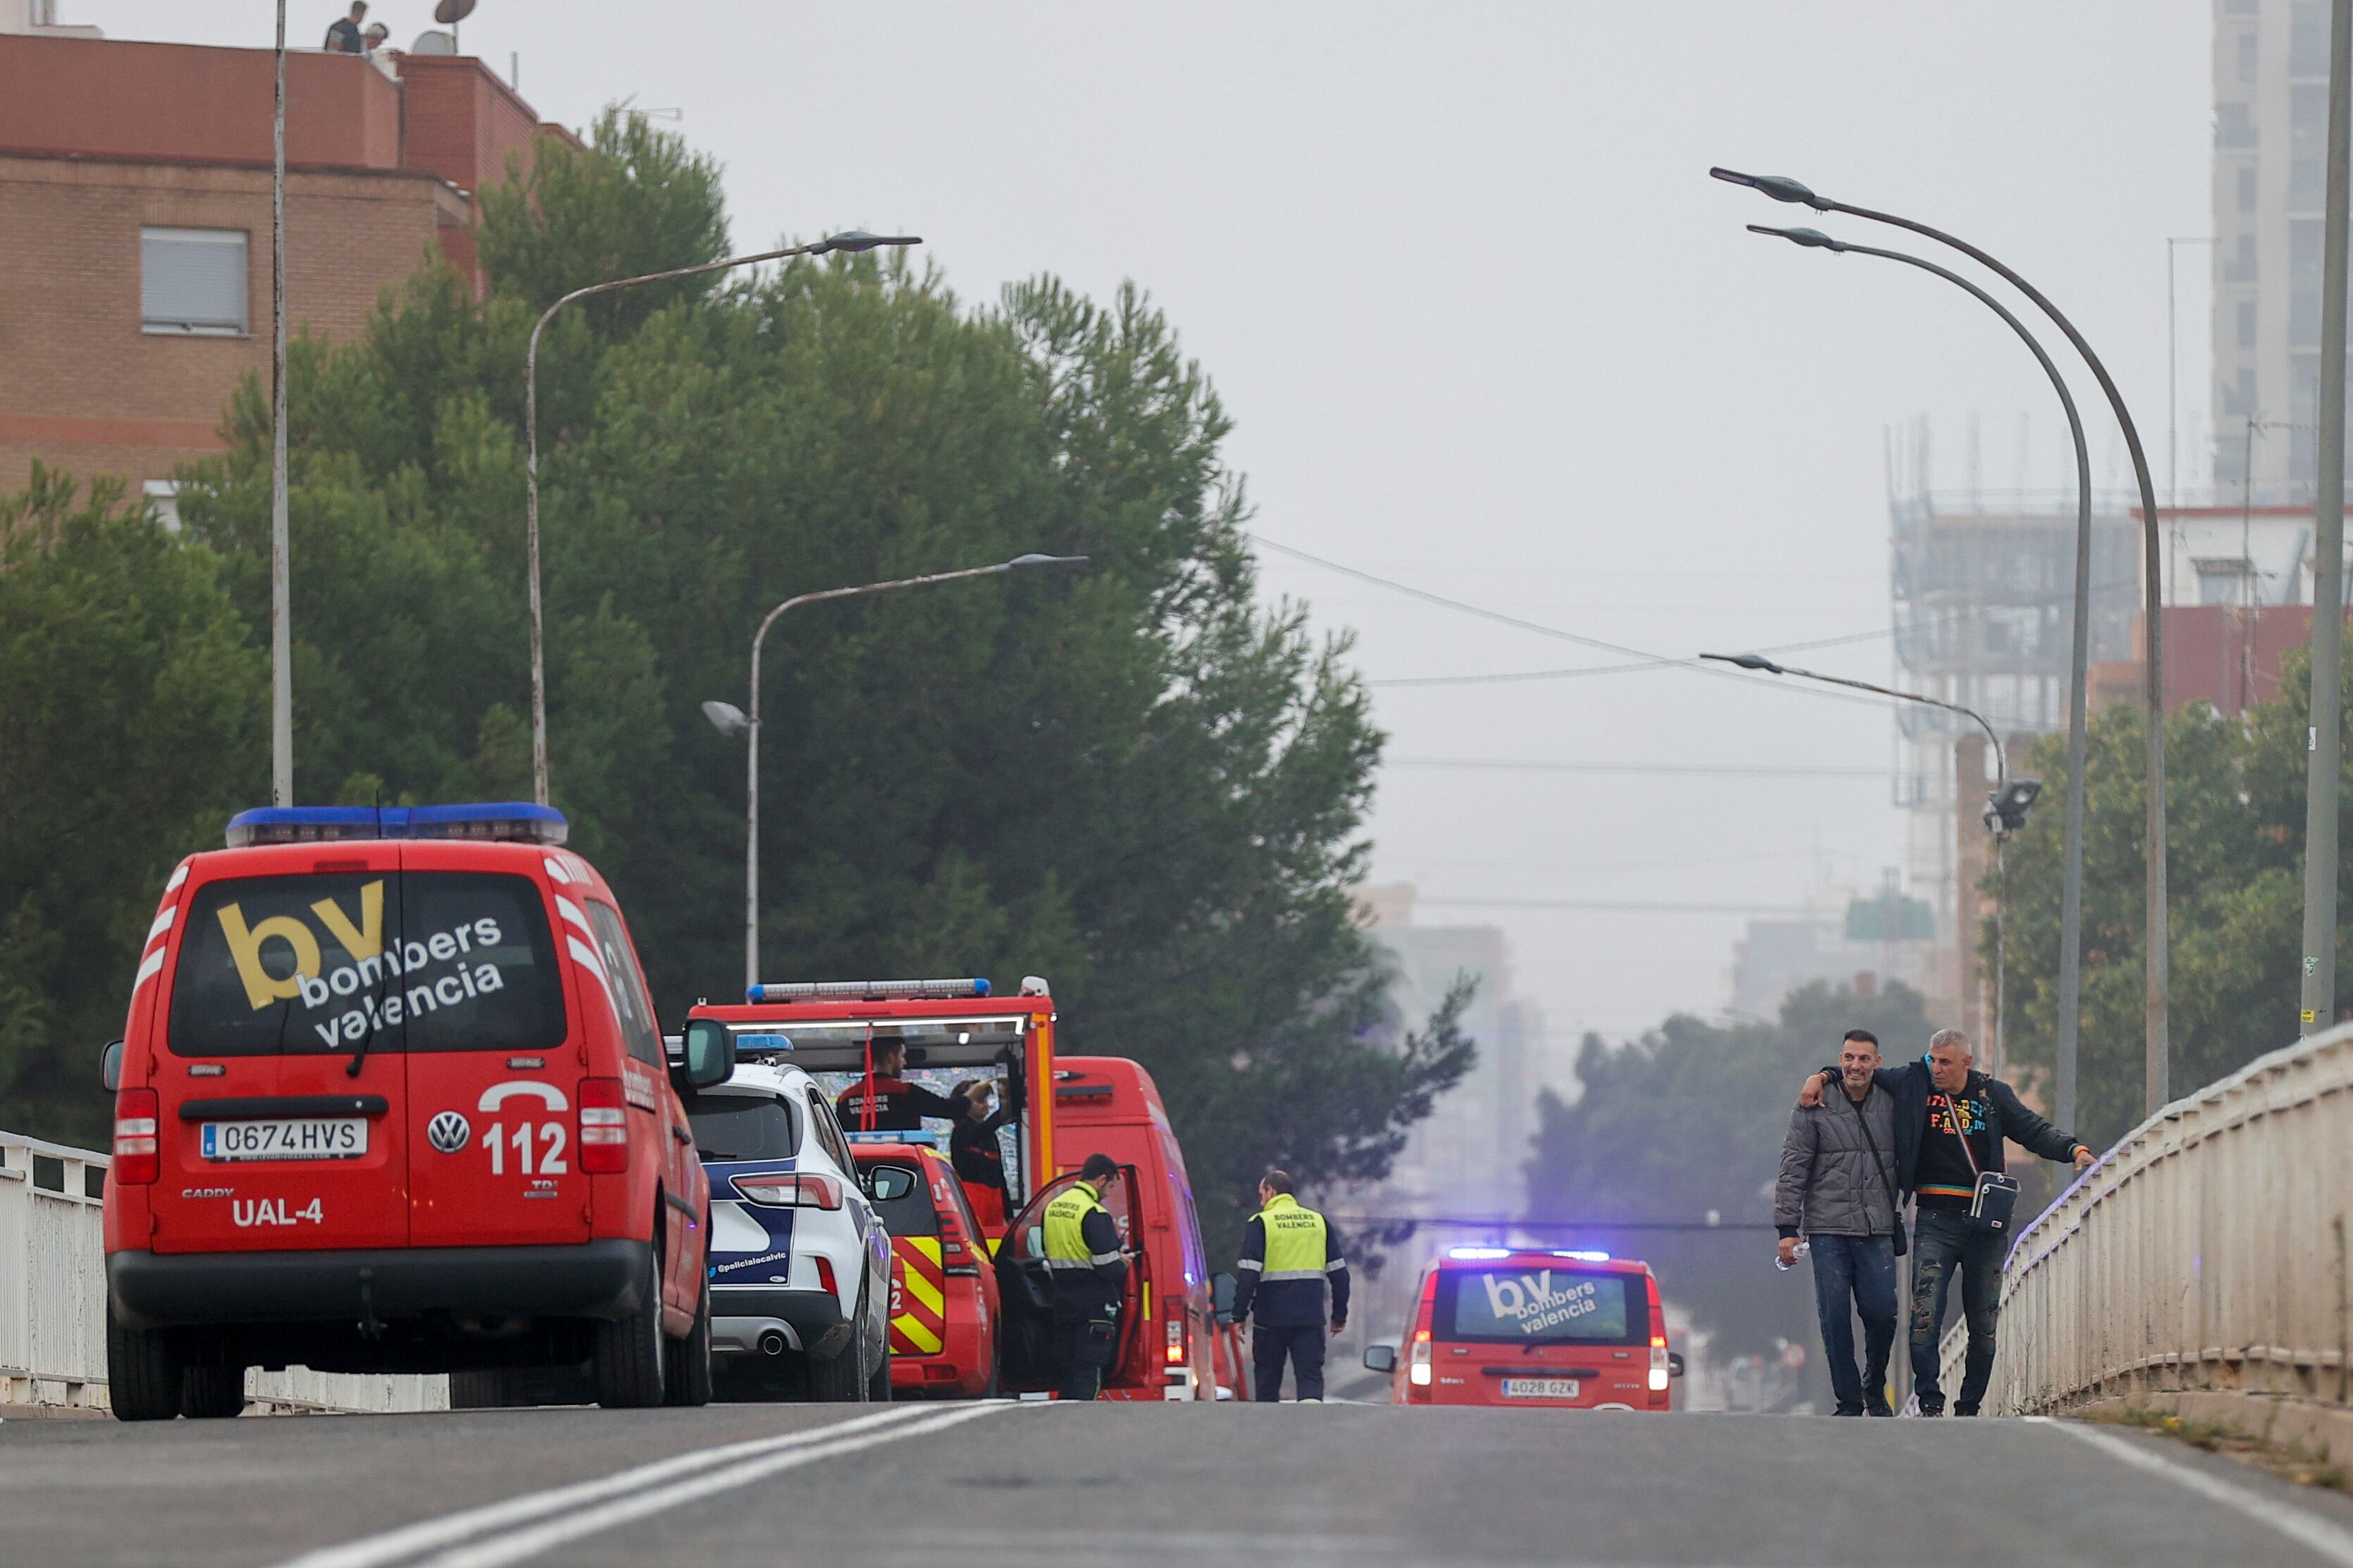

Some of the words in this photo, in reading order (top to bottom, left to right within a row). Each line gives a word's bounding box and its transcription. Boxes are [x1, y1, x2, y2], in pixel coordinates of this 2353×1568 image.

[217, 879, 383, 1010] bv
[296, 917, 501, 1009] bombers
[315, 962, 504, 1048] valencia
[482, 1121, 568, 1174] 112
[182, 1188, 235, 1198] CADDY
[233, 1198, 323, 1227] UAL-4
[718, 1253, 786, 1273] @policialocalvlc
[1483, 1269, 1551, 1318] bv
[1516, 1281, 1595, 1319] bombers
[1521, 1298, 1596, 1334] valencia
